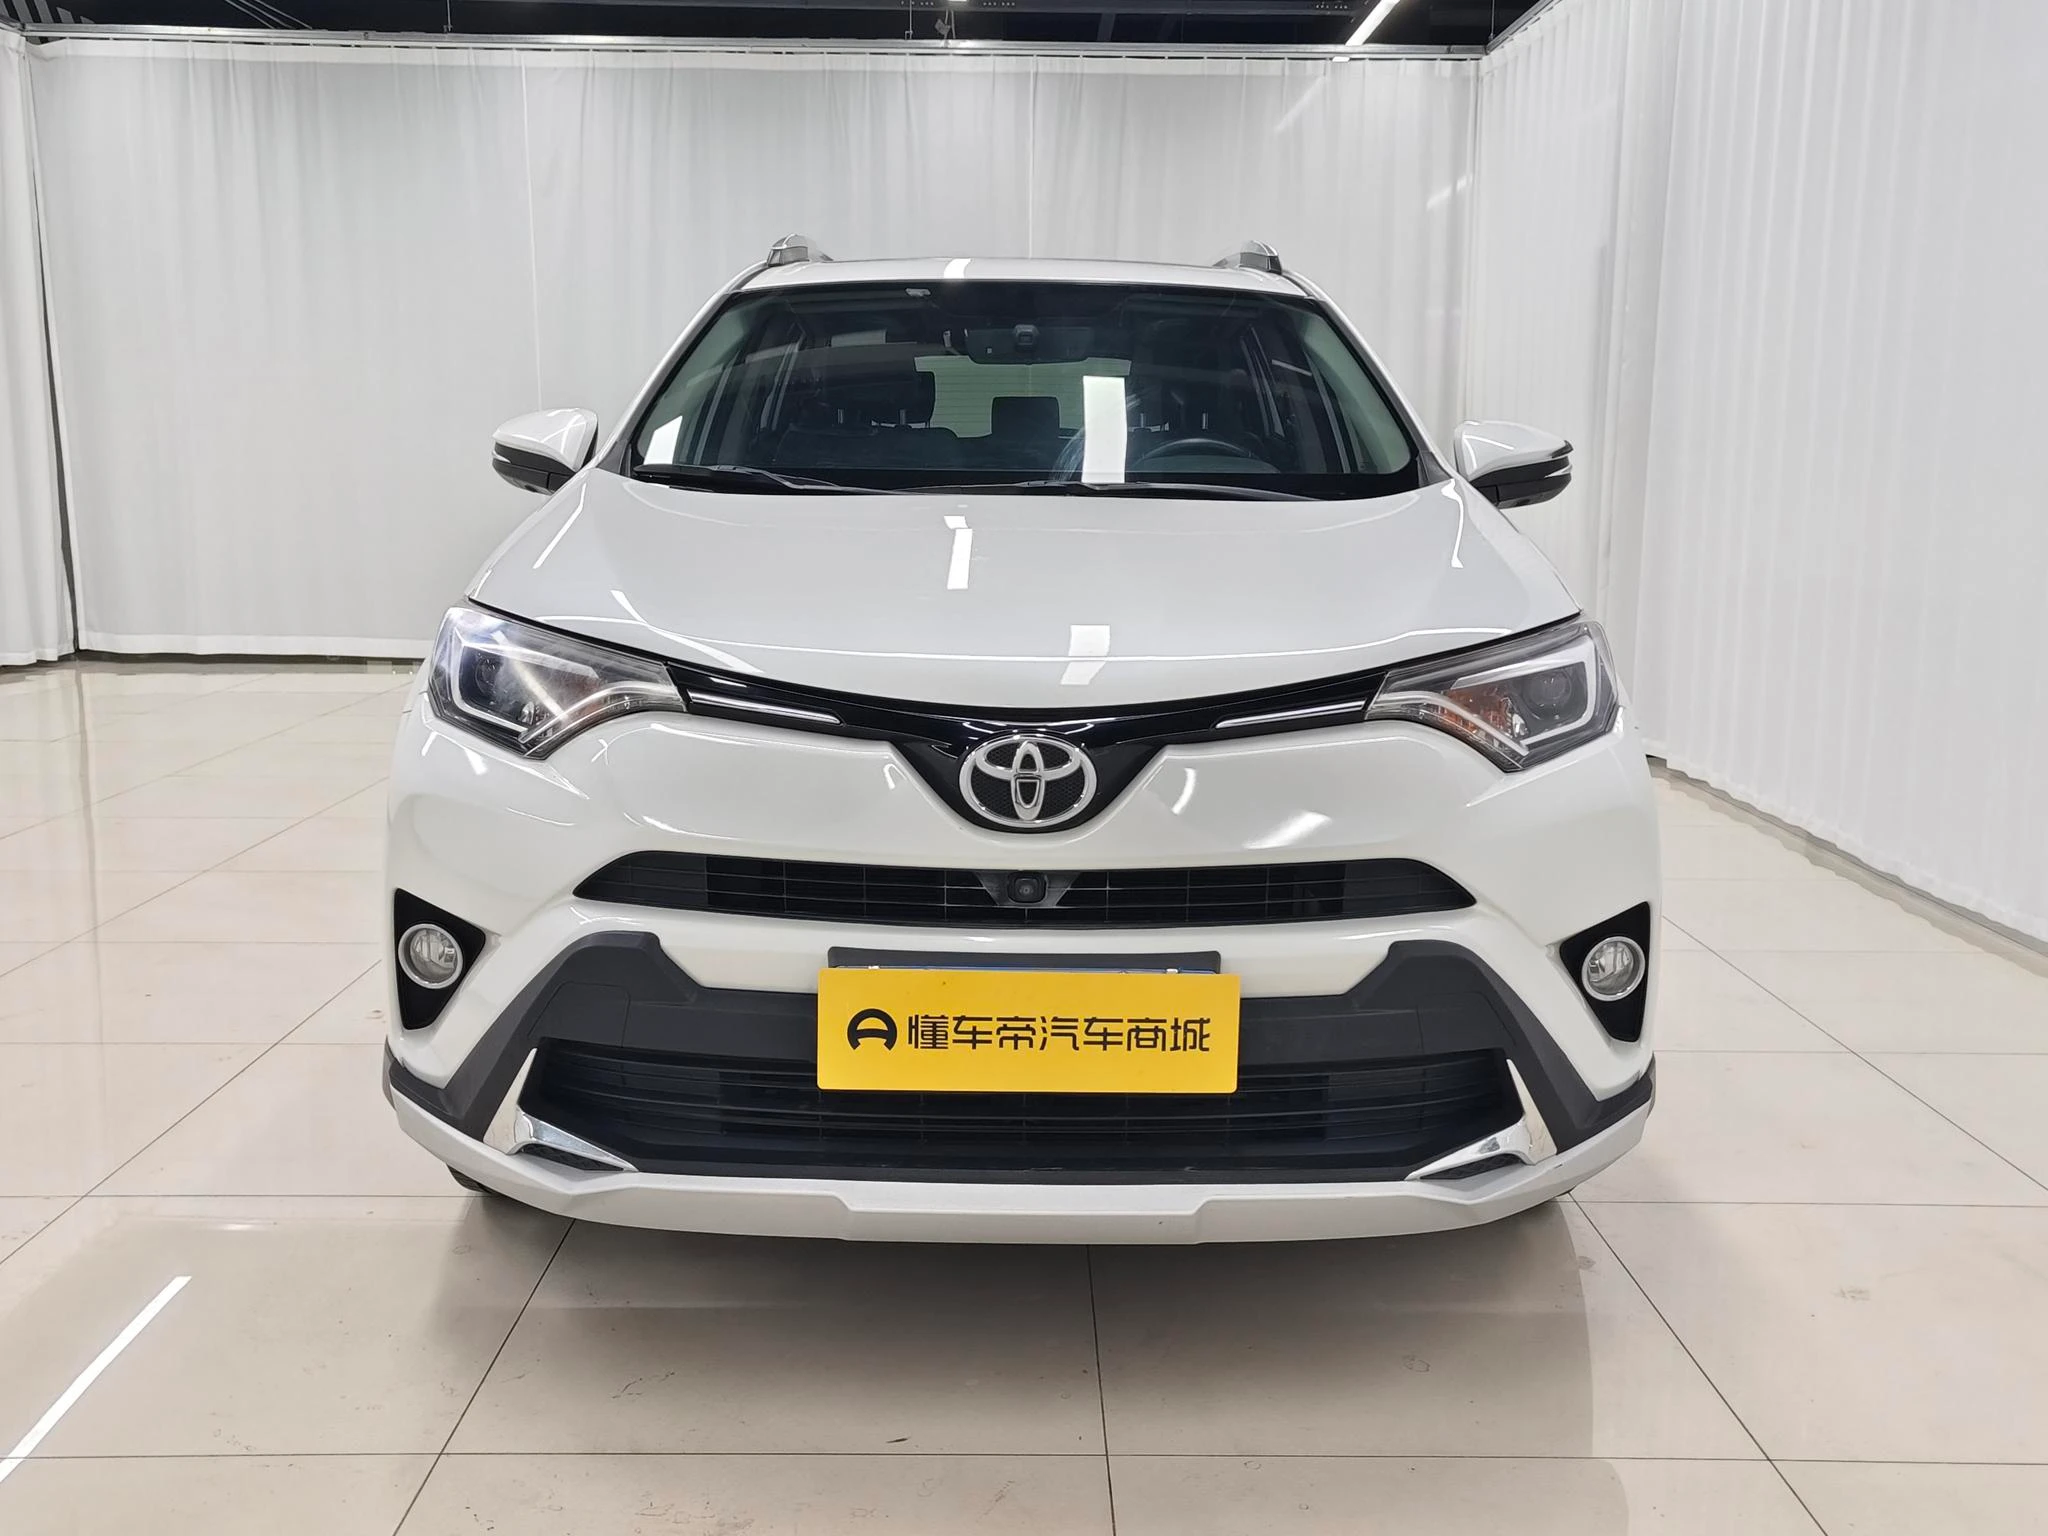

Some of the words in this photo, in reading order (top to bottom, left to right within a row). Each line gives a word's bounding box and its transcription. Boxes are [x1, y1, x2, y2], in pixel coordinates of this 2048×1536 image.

[907, 1014, 1211, 1052] 懂车帝汽车商城
